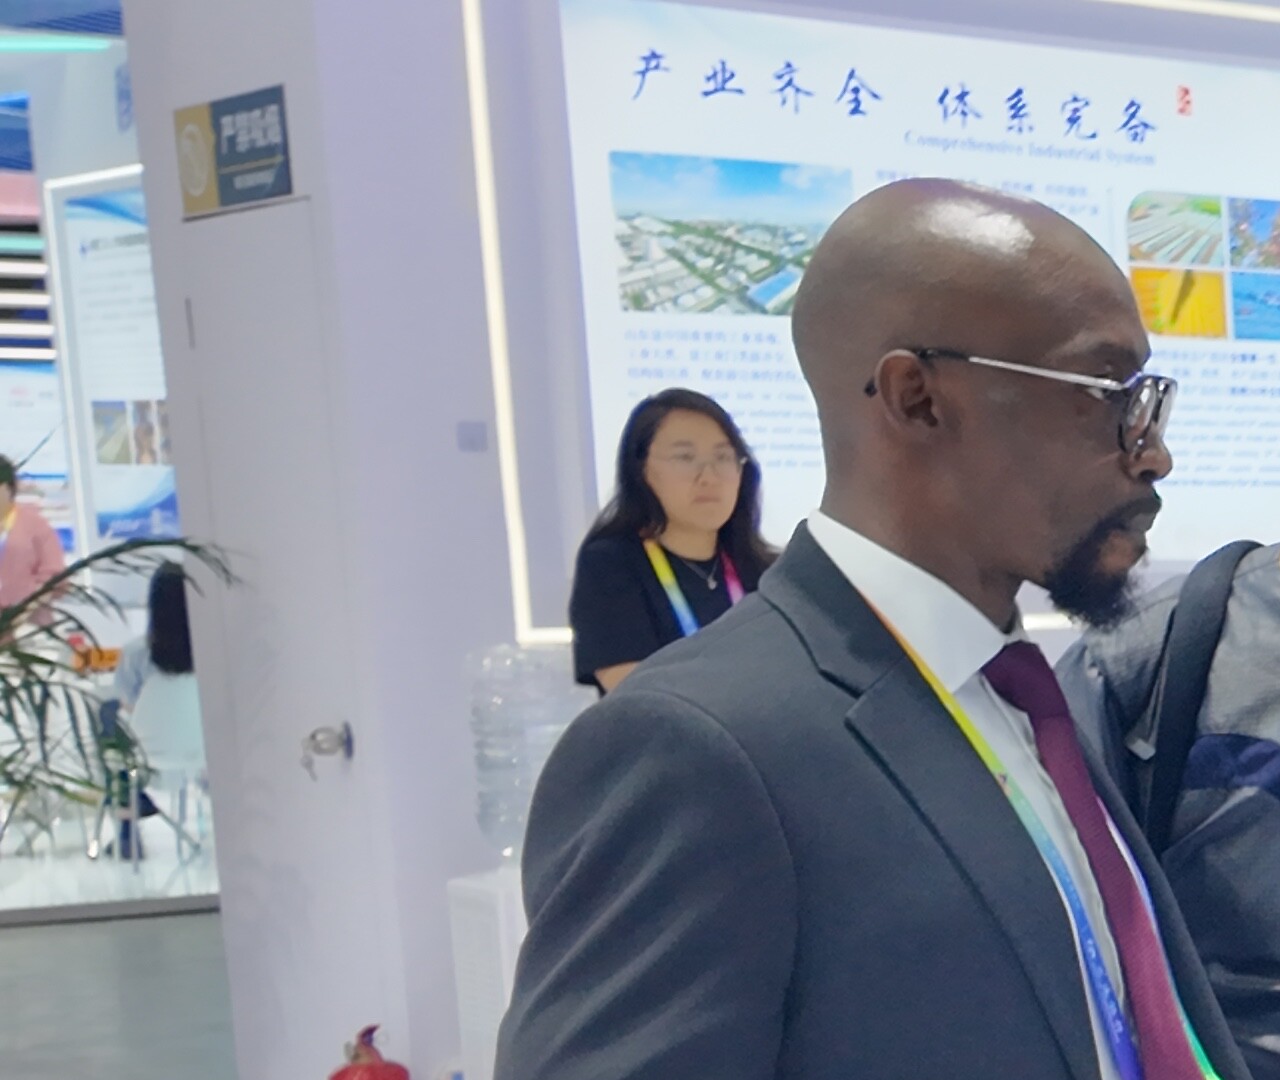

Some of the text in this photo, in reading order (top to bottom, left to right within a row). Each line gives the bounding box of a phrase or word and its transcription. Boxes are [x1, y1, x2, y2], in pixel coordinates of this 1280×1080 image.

[632, 48, 883, 116] 产业齐全
[936, 82, 1158, 144] 体系完备
